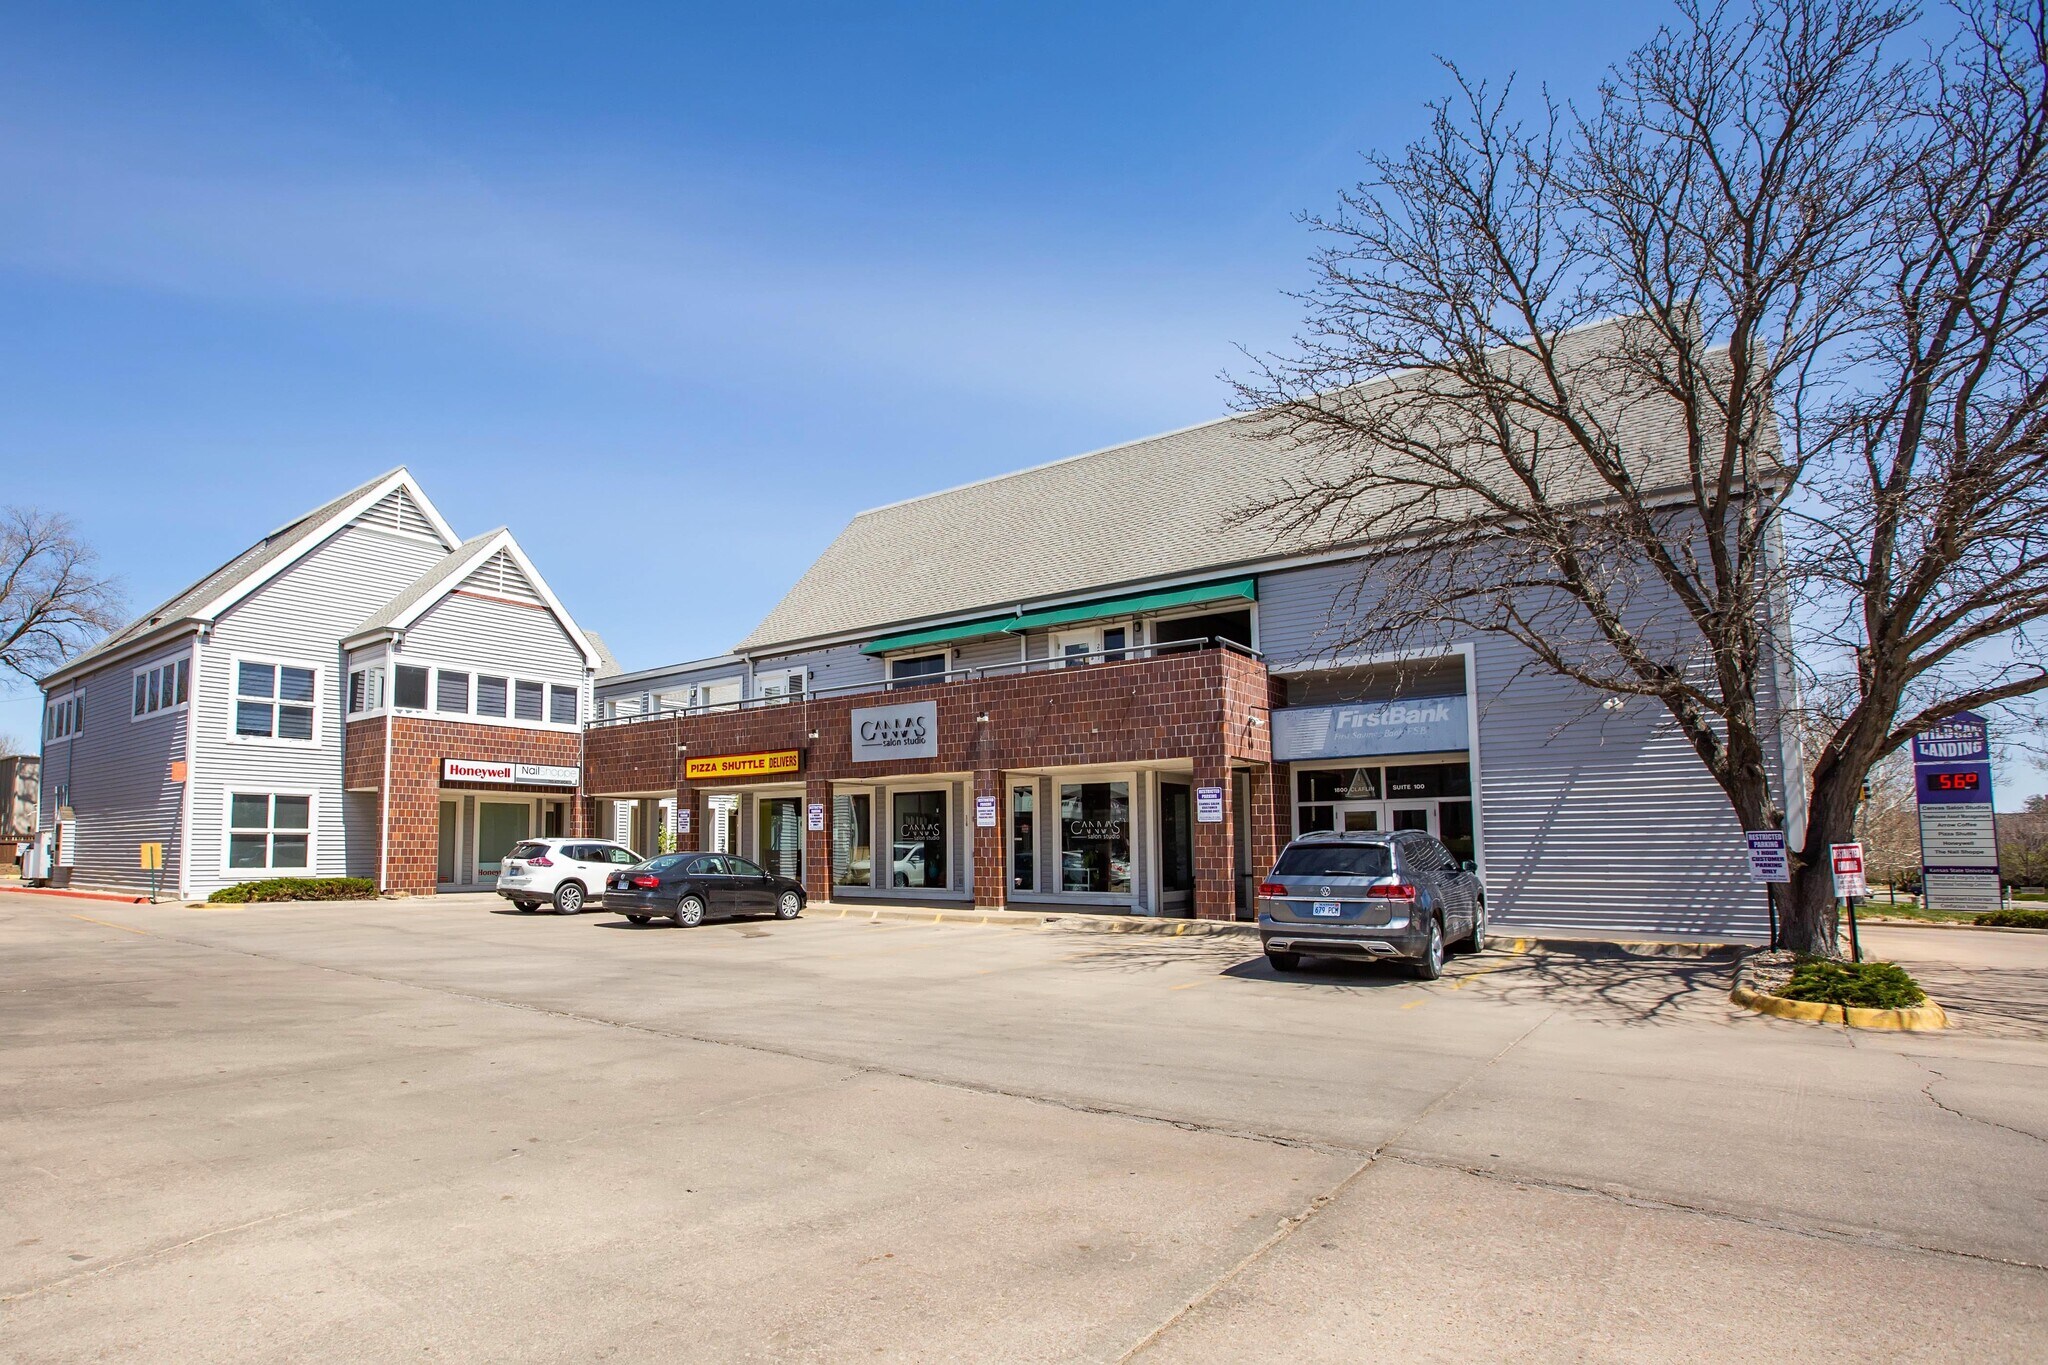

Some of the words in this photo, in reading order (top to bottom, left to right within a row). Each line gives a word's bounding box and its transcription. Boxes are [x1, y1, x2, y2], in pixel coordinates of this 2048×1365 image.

[1336, 704, 1450, 729] FirstBank
[861, 716, 926, 741] CANVAS
[883, 738, 901, 747] salon
[904, 736, 926, 746] studio
[1920, 742, 1983, 757] LANDING
[691, 763, 717, 772] PIZZA
[722, 760, 765, 771] SHUTTLE
[769, 755, 797, 768] DELIVERS
[450, 764, 511, 779] Honeywell
[900, 823, 940, 836] CANVAS
[1071, 820, 1120, 834] CANVAS
[479, 869, 501, 877] Honey
[1315, 906, 1325, 914] 679
